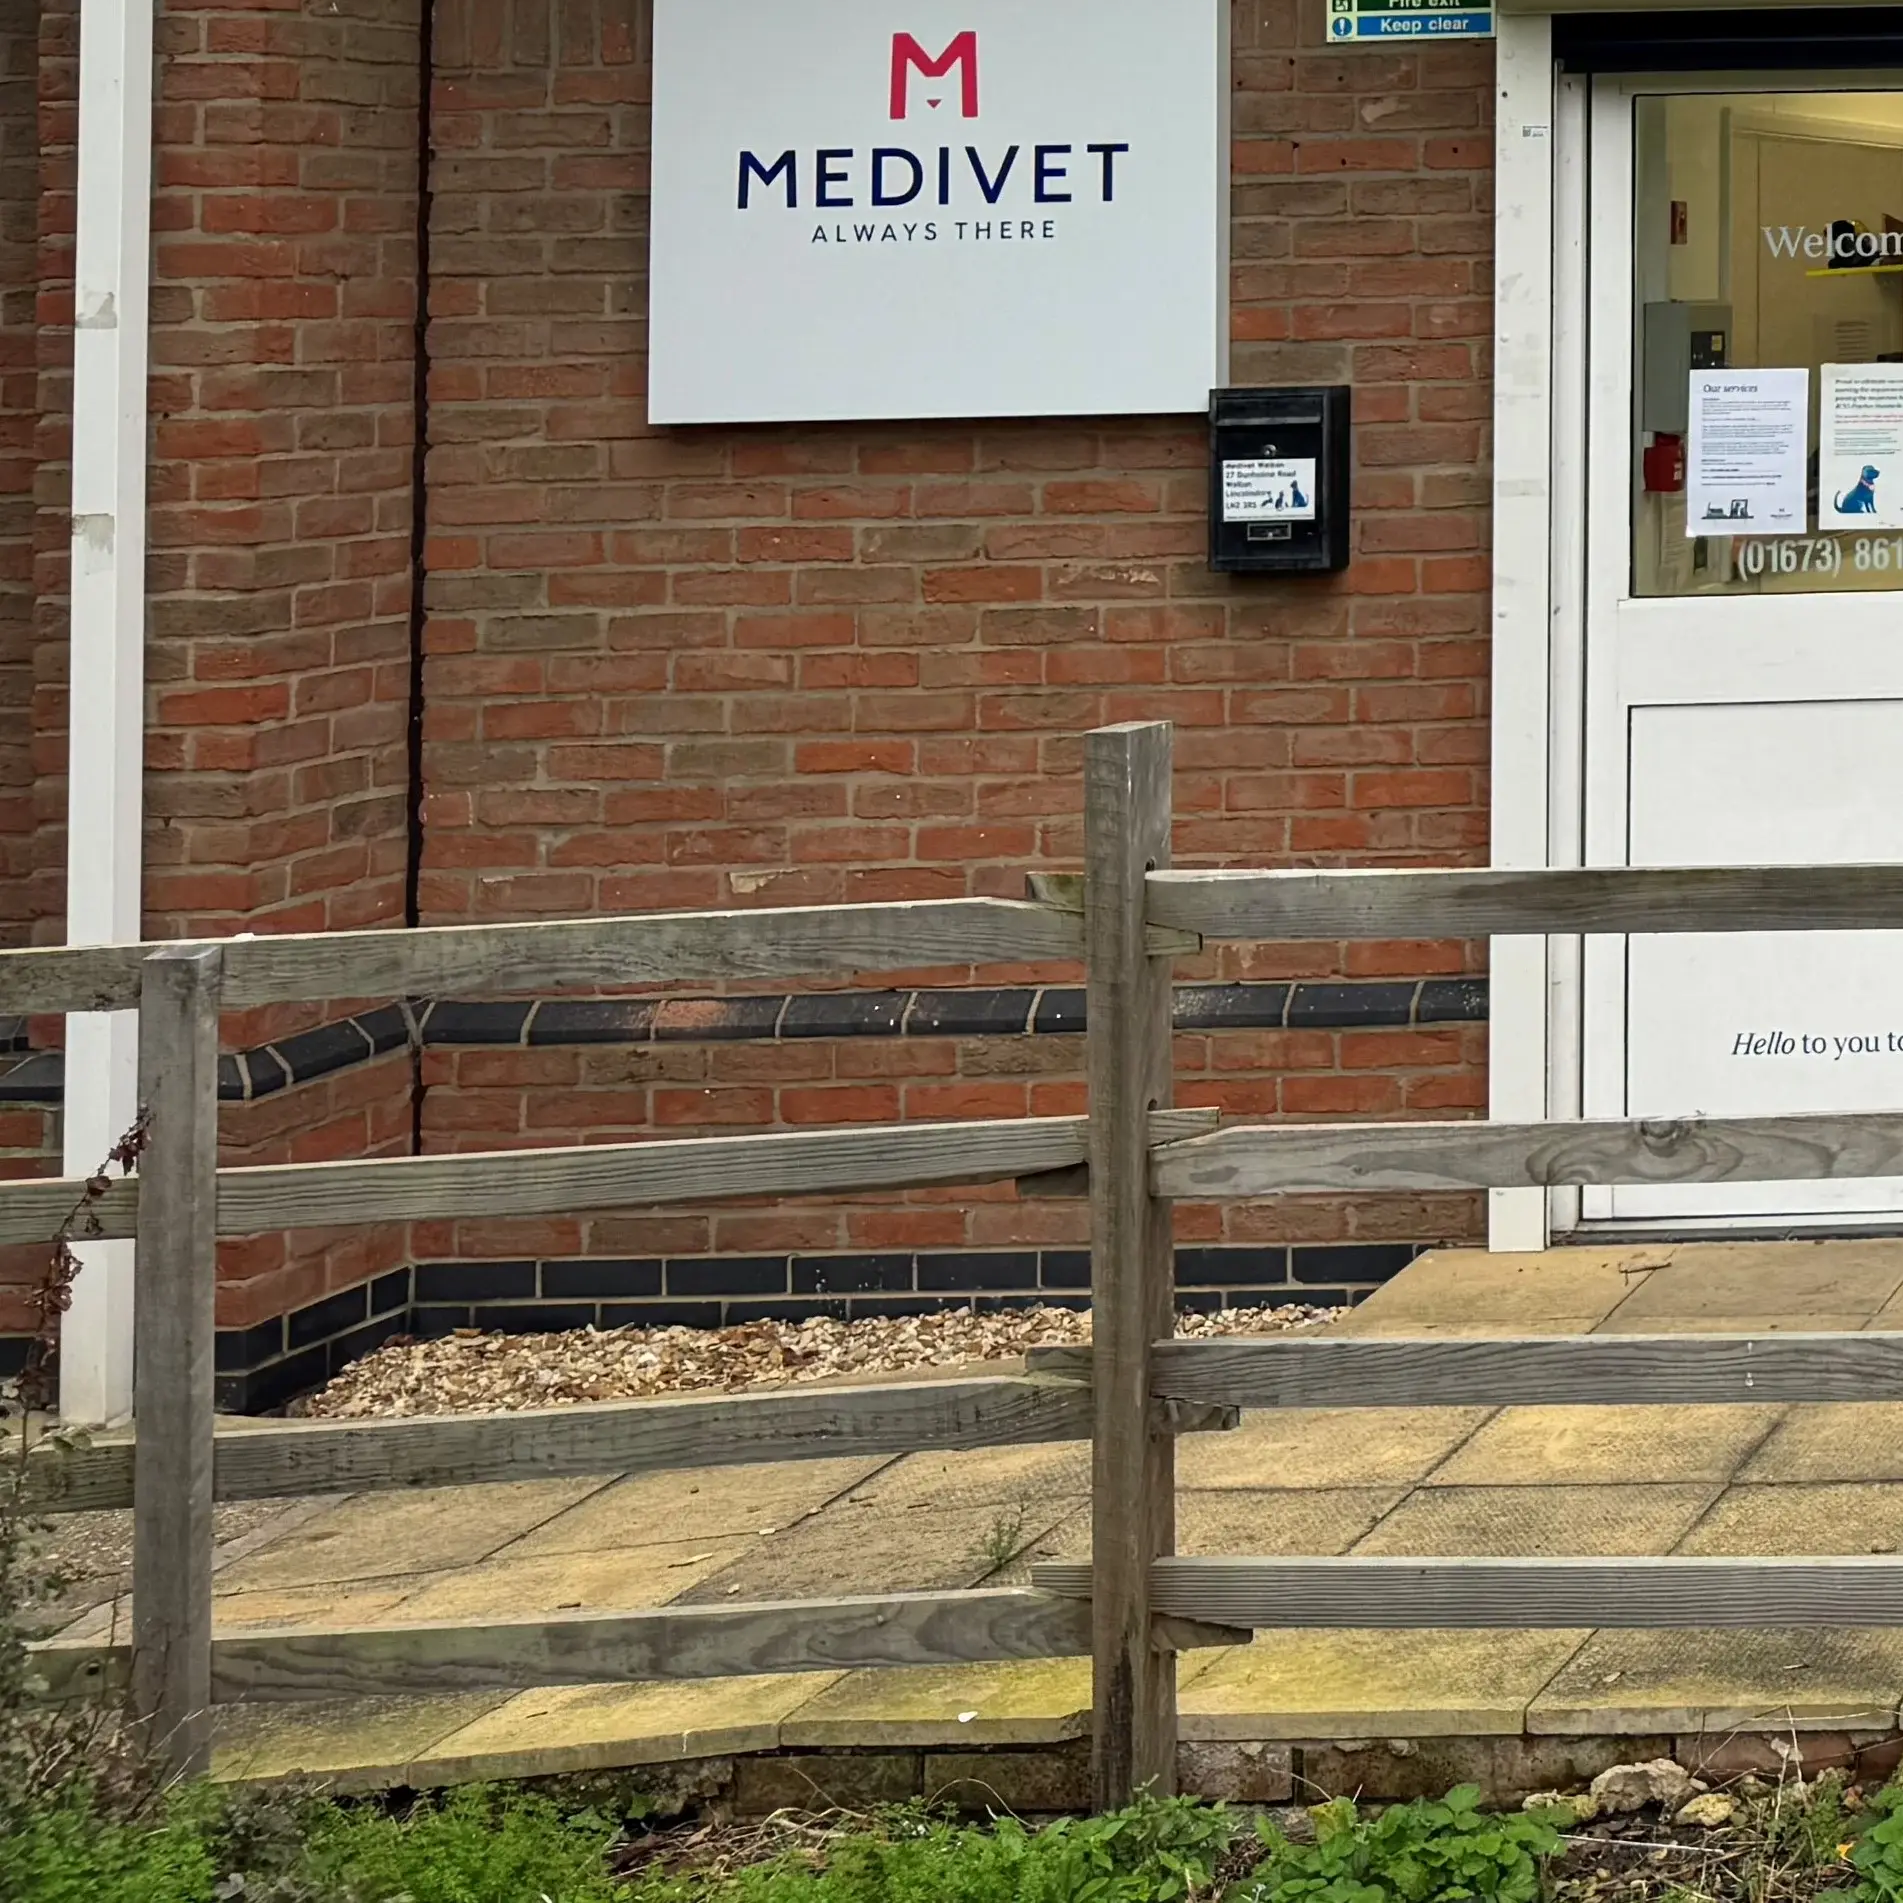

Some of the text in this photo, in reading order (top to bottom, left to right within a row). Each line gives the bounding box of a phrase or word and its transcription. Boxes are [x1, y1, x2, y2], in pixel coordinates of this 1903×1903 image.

[1380, 16, 1469, 35] Keep clear
[736, 142, 1129, 210] MEDIVET
[811, 219, 1057, 244] ALWAYS THERE
[1703, 384, 1721, 393] Our
[1738, 537, 1842, 582] (01673)
[1731, 1031, 1796, 1057] Hello
[1801, 1033, 1827, 1055] to
[1833, 1033, 1880, 1060] you
